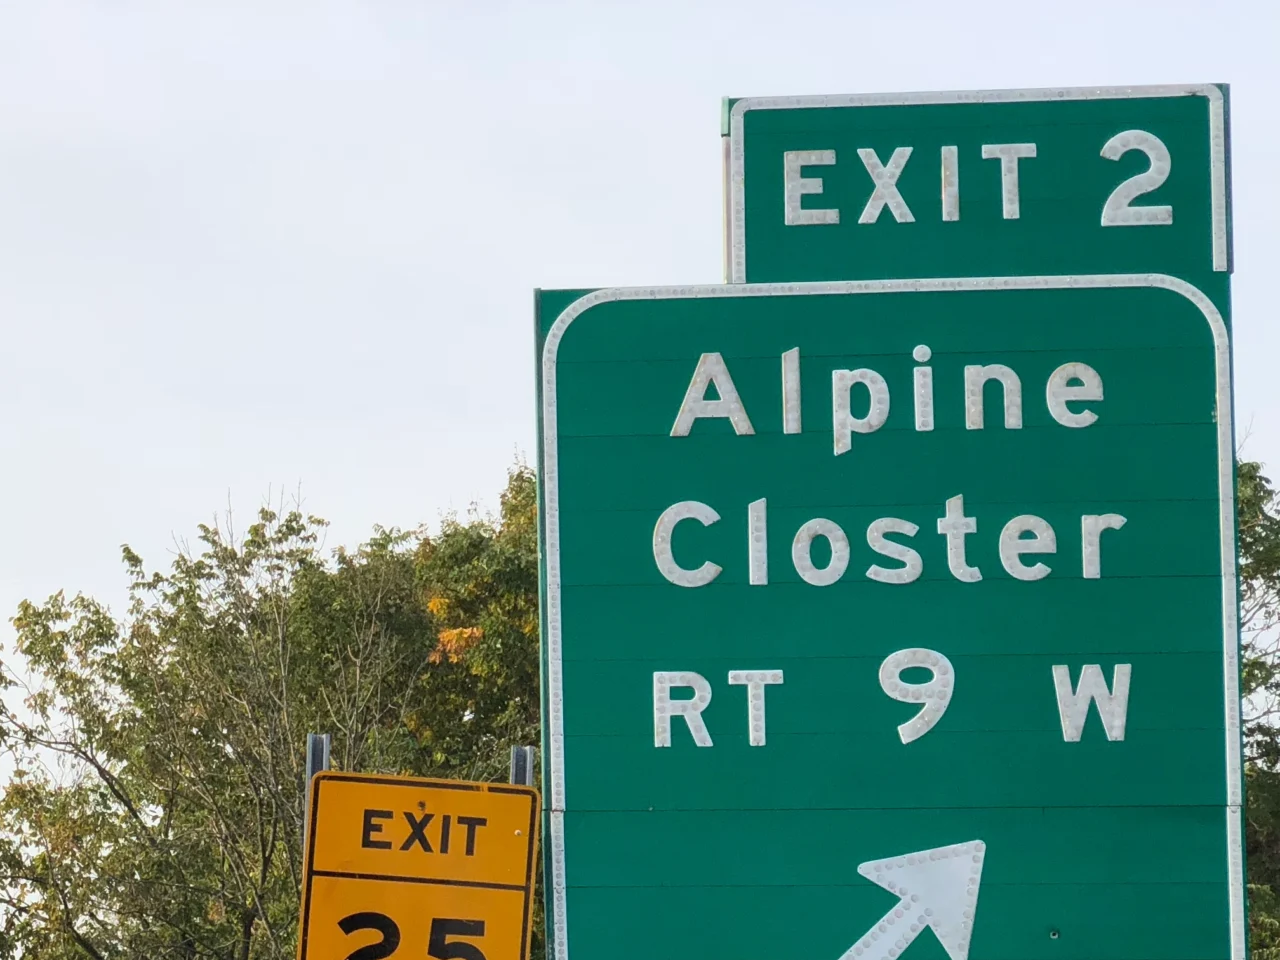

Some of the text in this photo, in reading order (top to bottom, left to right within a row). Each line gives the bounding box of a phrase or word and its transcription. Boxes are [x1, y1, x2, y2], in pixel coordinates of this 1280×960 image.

[783, 129, 1174, 227] EXIT 2
[669, 344, 1105, 456] Alpine
[652, 494, 1128, 588] Closter
[652, 647, 1132, 748] RT 9 W
[360, 808, 489, 857] EXIT
